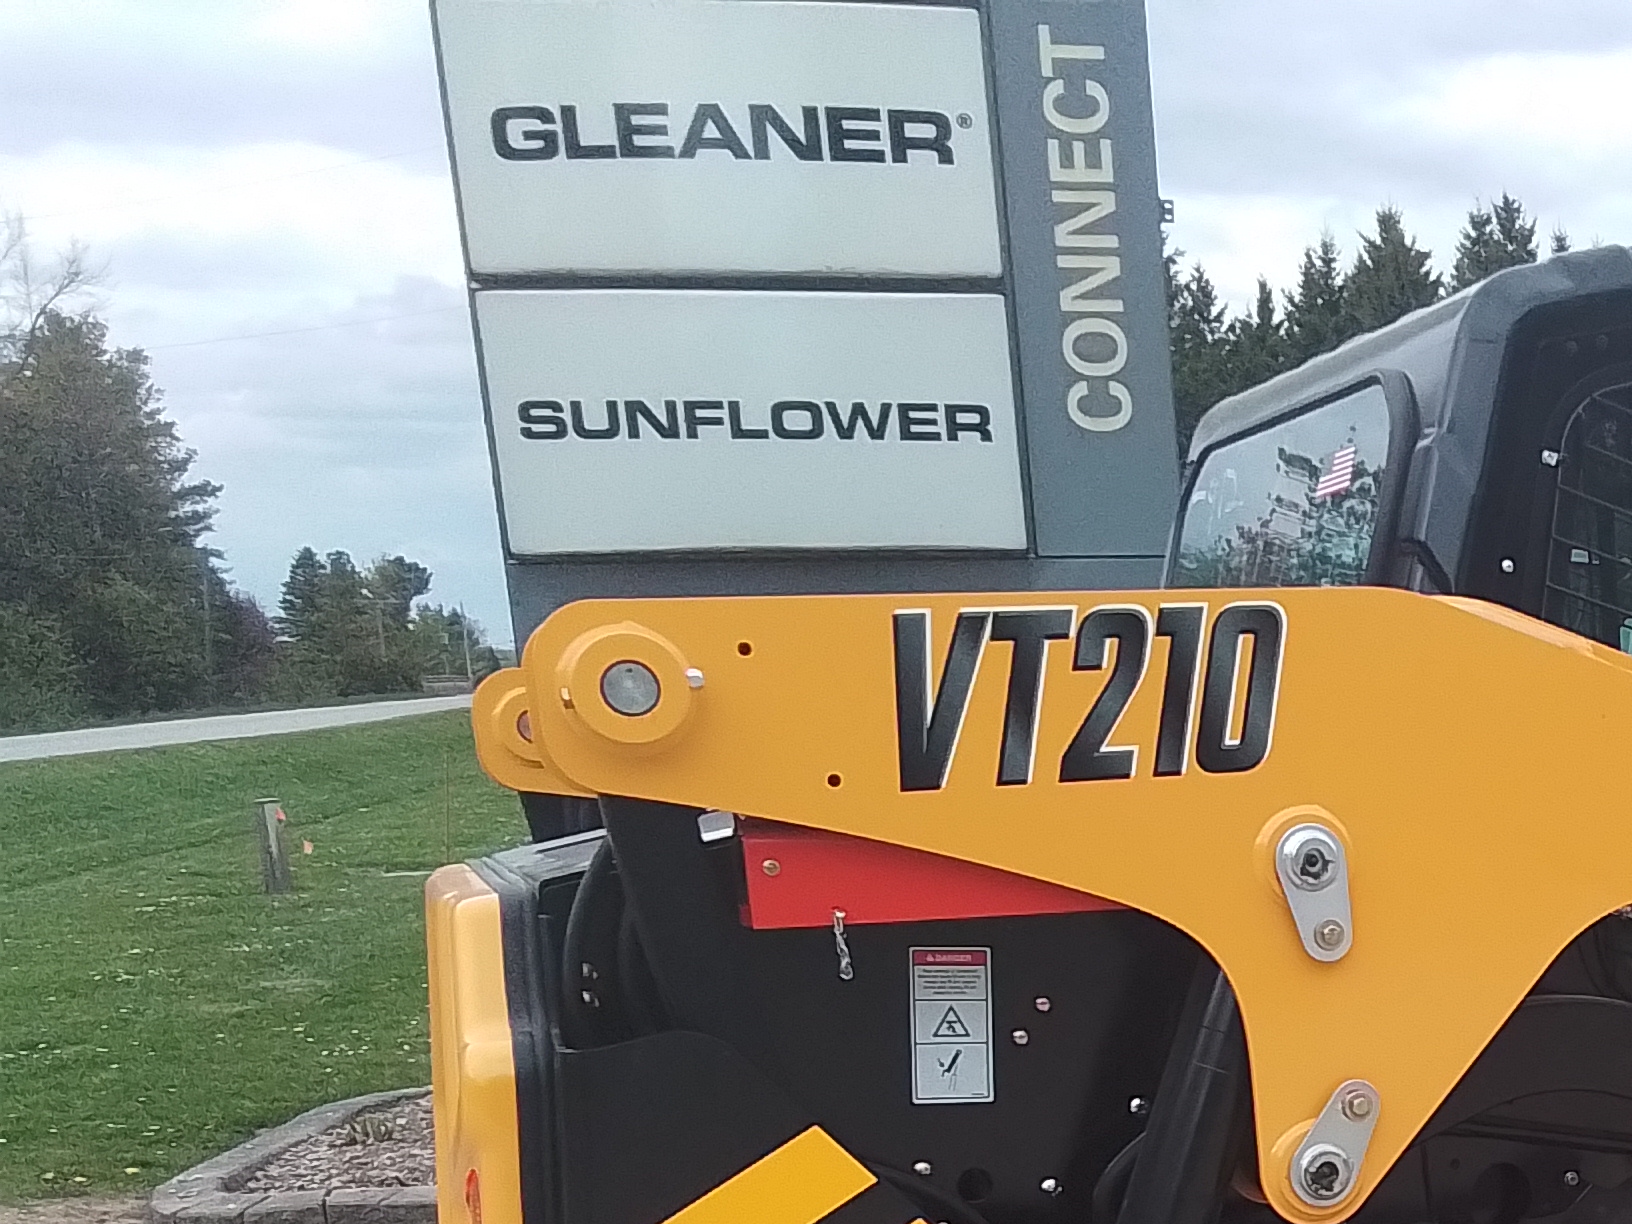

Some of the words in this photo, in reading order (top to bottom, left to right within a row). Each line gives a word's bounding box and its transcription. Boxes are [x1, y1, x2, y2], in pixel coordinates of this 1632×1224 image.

[1038, 23, 1133, 432] CONNECT
[517, 398, 993, 443] SUNFLOWER
[892, 600, 1287, 792] VT210
